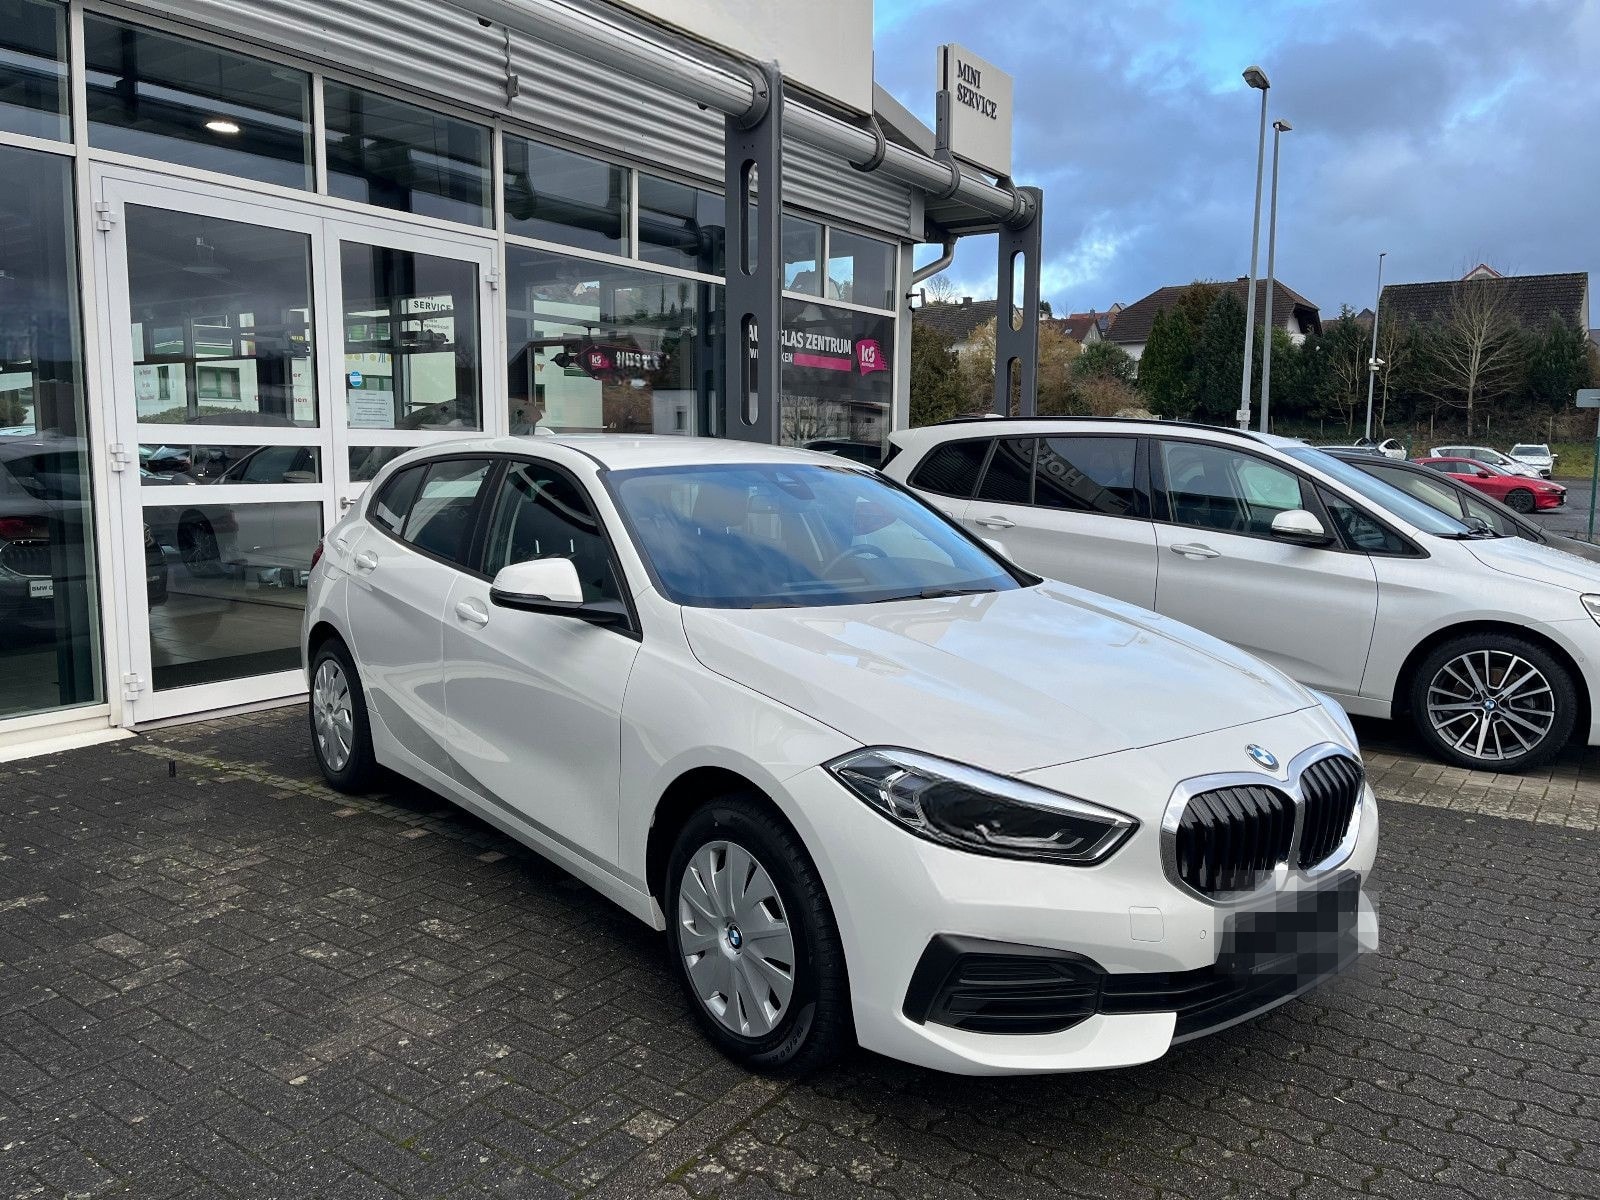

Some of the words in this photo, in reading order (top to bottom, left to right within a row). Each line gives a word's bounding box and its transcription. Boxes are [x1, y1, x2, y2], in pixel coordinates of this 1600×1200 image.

[957, 59, 981, 89] MINI
[957, 82, 997, 120] SERVICE
[413, 300, 452, 311] SERVICE
[805, 333, 852, 355] ZENTRUM
